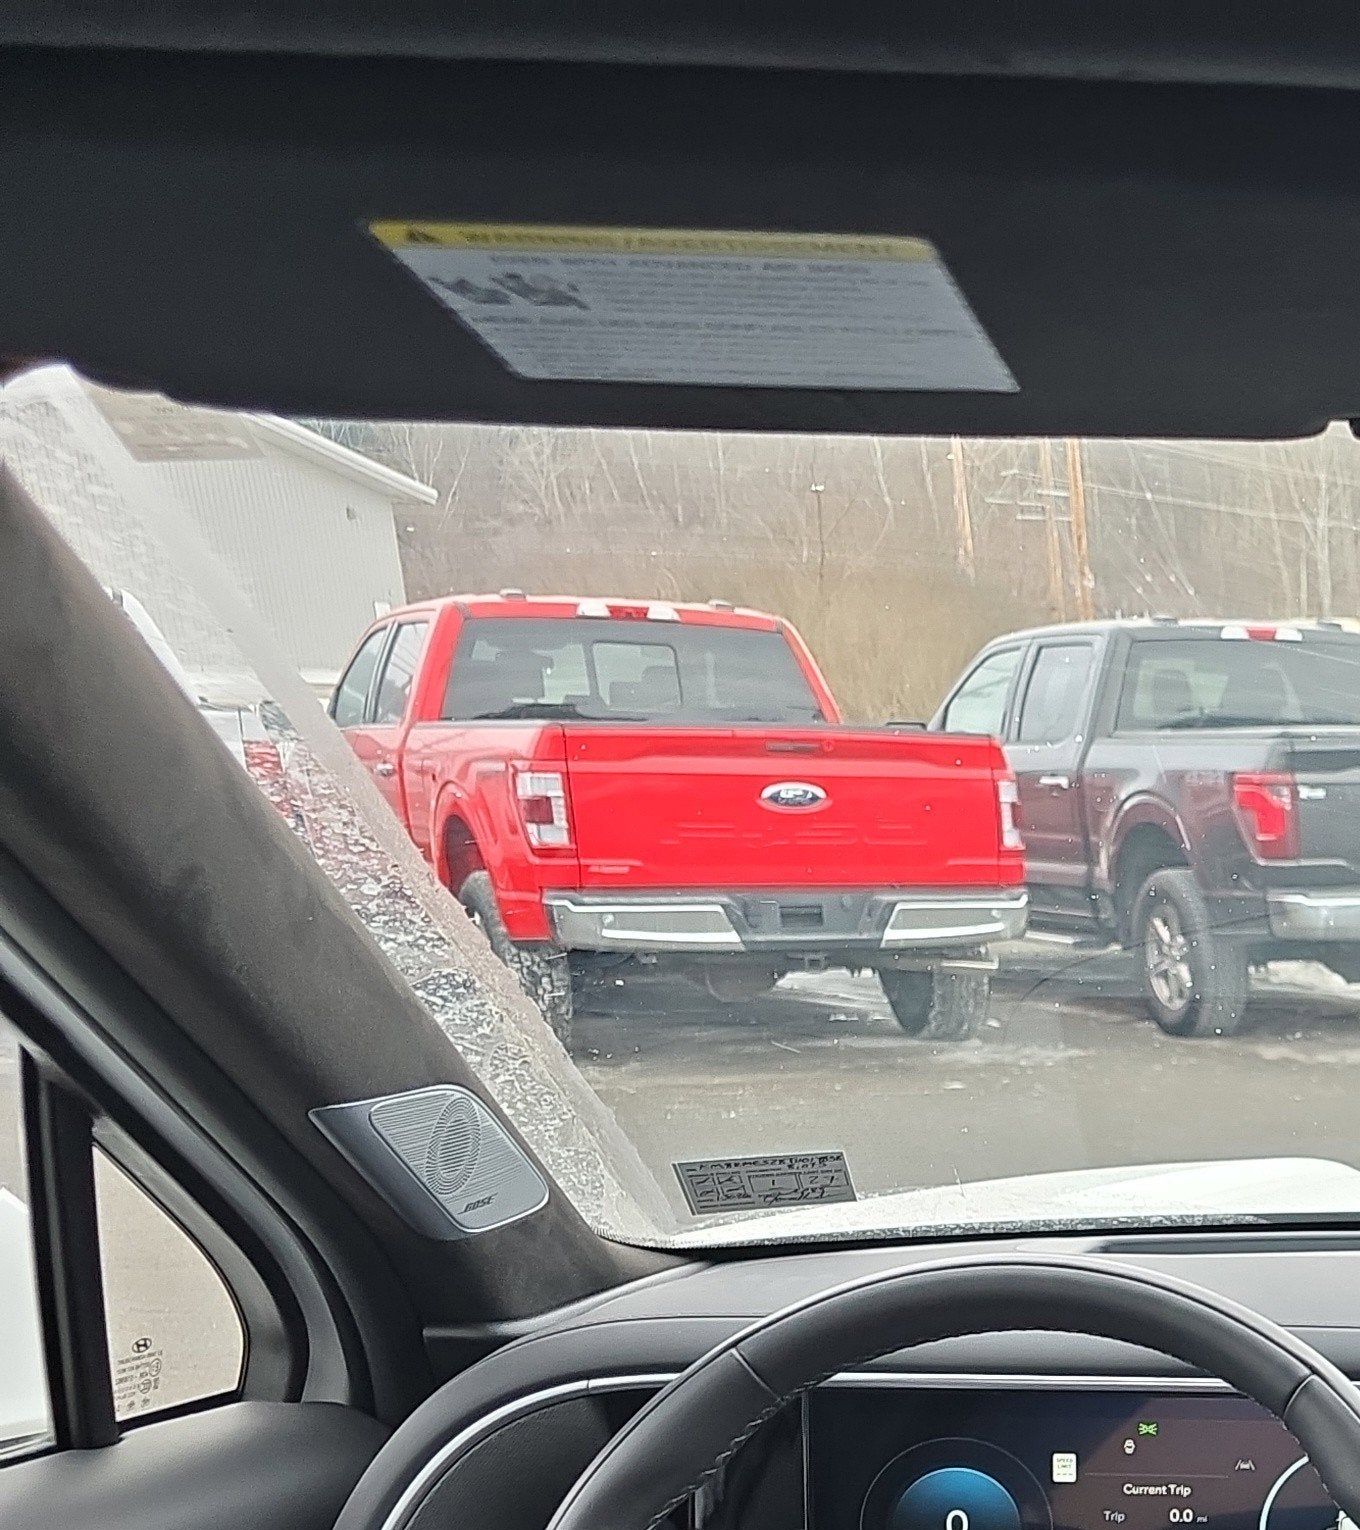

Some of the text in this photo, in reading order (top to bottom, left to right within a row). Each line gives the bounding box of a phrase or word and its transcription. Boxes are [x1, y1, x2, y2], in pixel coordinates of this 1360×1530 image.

[457, 1192, 498, 1214] BOSE
[1123, 1483, 1192, 1497] Current Trip
[1103, 1510, 1126, 1523] Trip
[1169, 1508, 1194, 1523] 0.0
